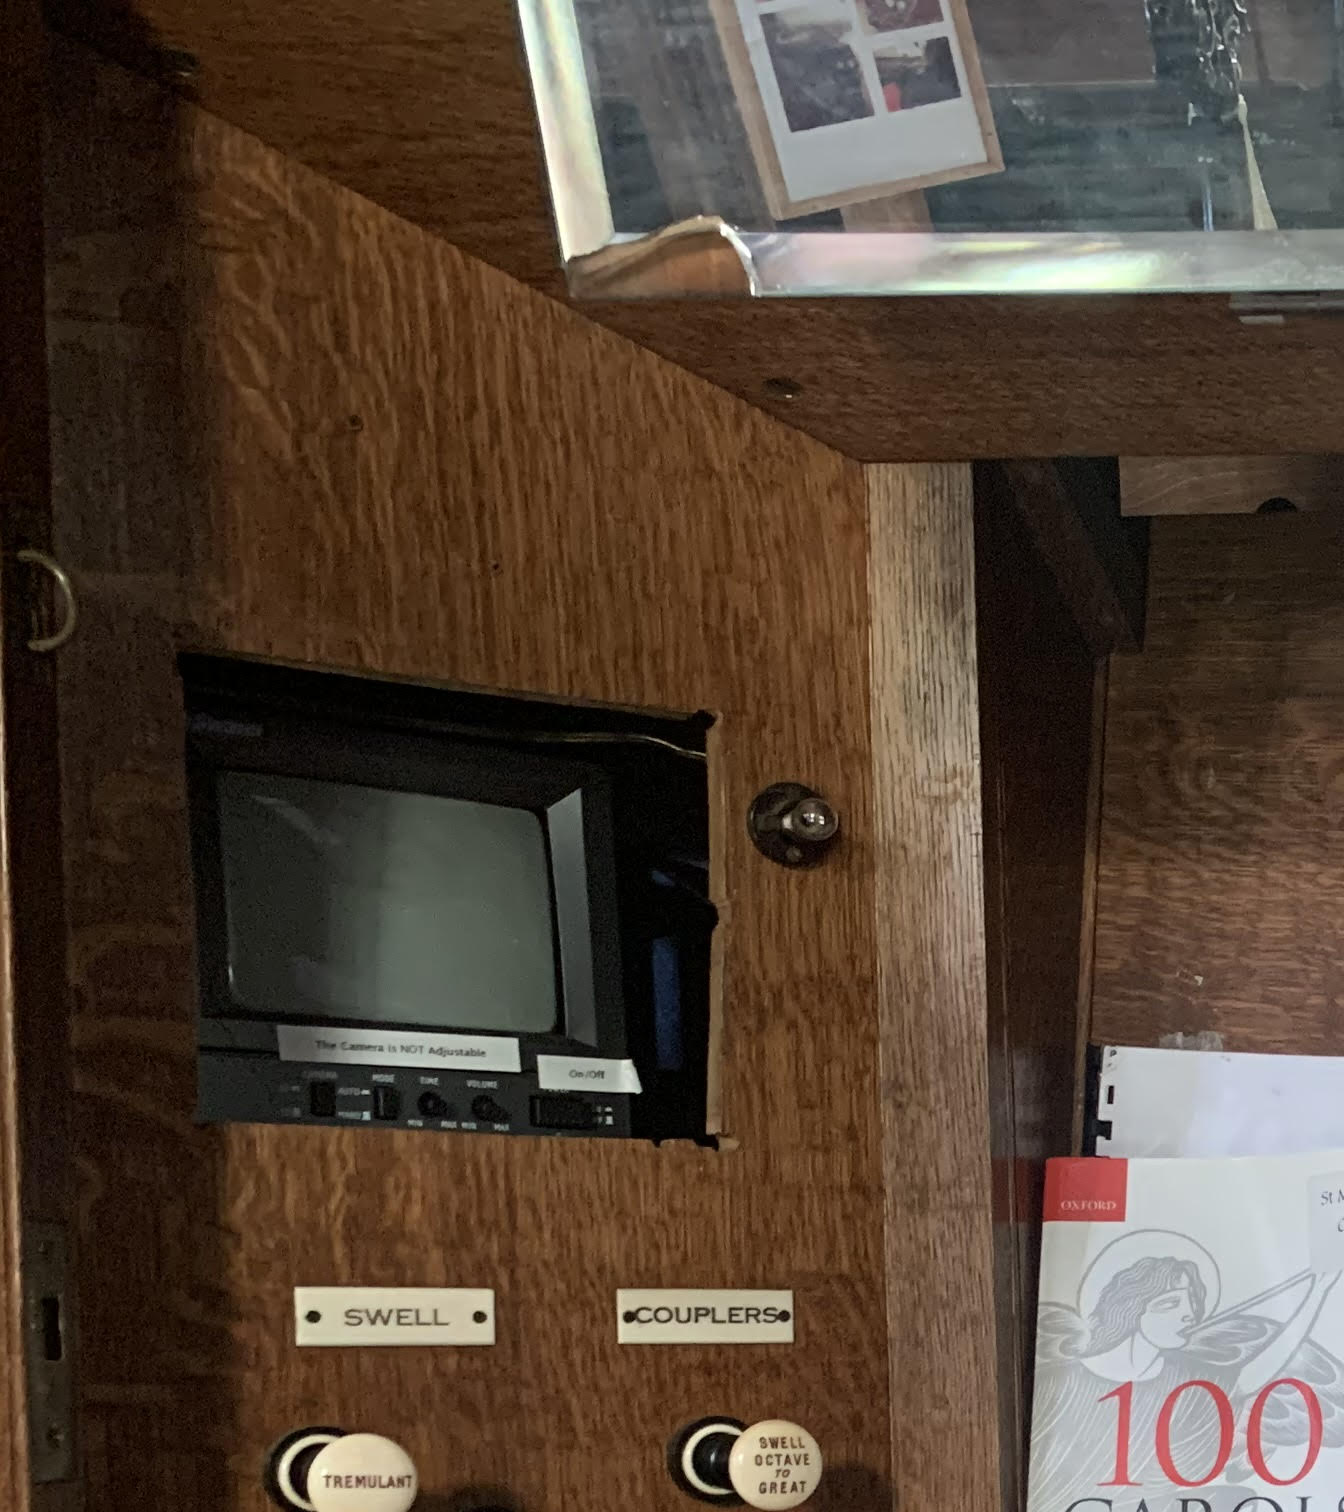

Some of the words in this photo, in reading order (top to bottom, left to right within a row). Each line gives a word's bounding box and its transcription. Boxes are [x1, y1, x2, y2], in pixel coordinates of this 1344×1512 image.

[315, 1039, 336, 1050] The
[341, 1041, 384, 1053] Camera
[388, 1042, 397, 1053] is
[401, 1044, 424, 1054] NOT
[428, 1046, 486, 1058] Adjustable
[568, 1069, 606, 1080] On/Off
[1060, 1199, 1117, 1211] OXFORD
[1320, 1190, 1333, 1206] St
[343, 1306, 451, 1328] SWELL
[634, 1305, 779, 1326] COUPLERS
[1097, 1377, 1324, 1488] 100
[759, 1436, 806, 1449] SWELL
[754, 1453, 811, 1467] OCTAVE
[775, 1469, 791, 1479] TO
[321, 1474, 413, 1489] TREMULANT
[758, 1481, 807, 1495] GREAT
